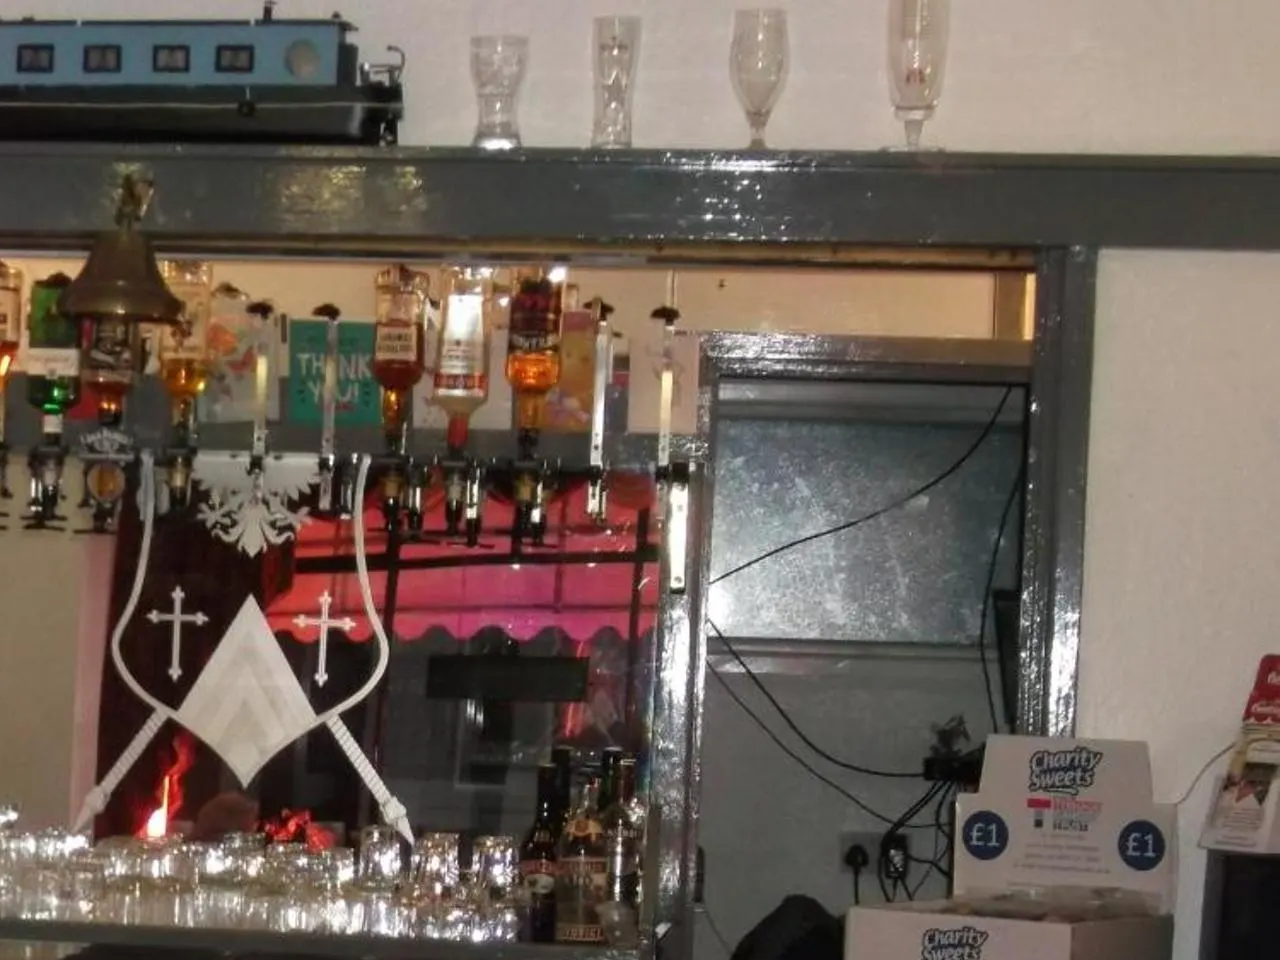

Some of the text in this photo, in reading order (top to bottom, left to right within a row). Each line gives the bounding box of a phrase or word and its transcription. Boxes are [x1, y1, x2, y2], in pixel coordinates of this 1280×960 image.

[296, 352, 372, 381] THNK
[306, 380, 359, 404] YU!
[1030, 746, 1103, 770] Charity
[1029, 768, 1095, 792] Sweets
[969, 822, 1000, 846] £1
[1125, 832, 1156, 857] £1
[923, 926, 989, 948] Charity
